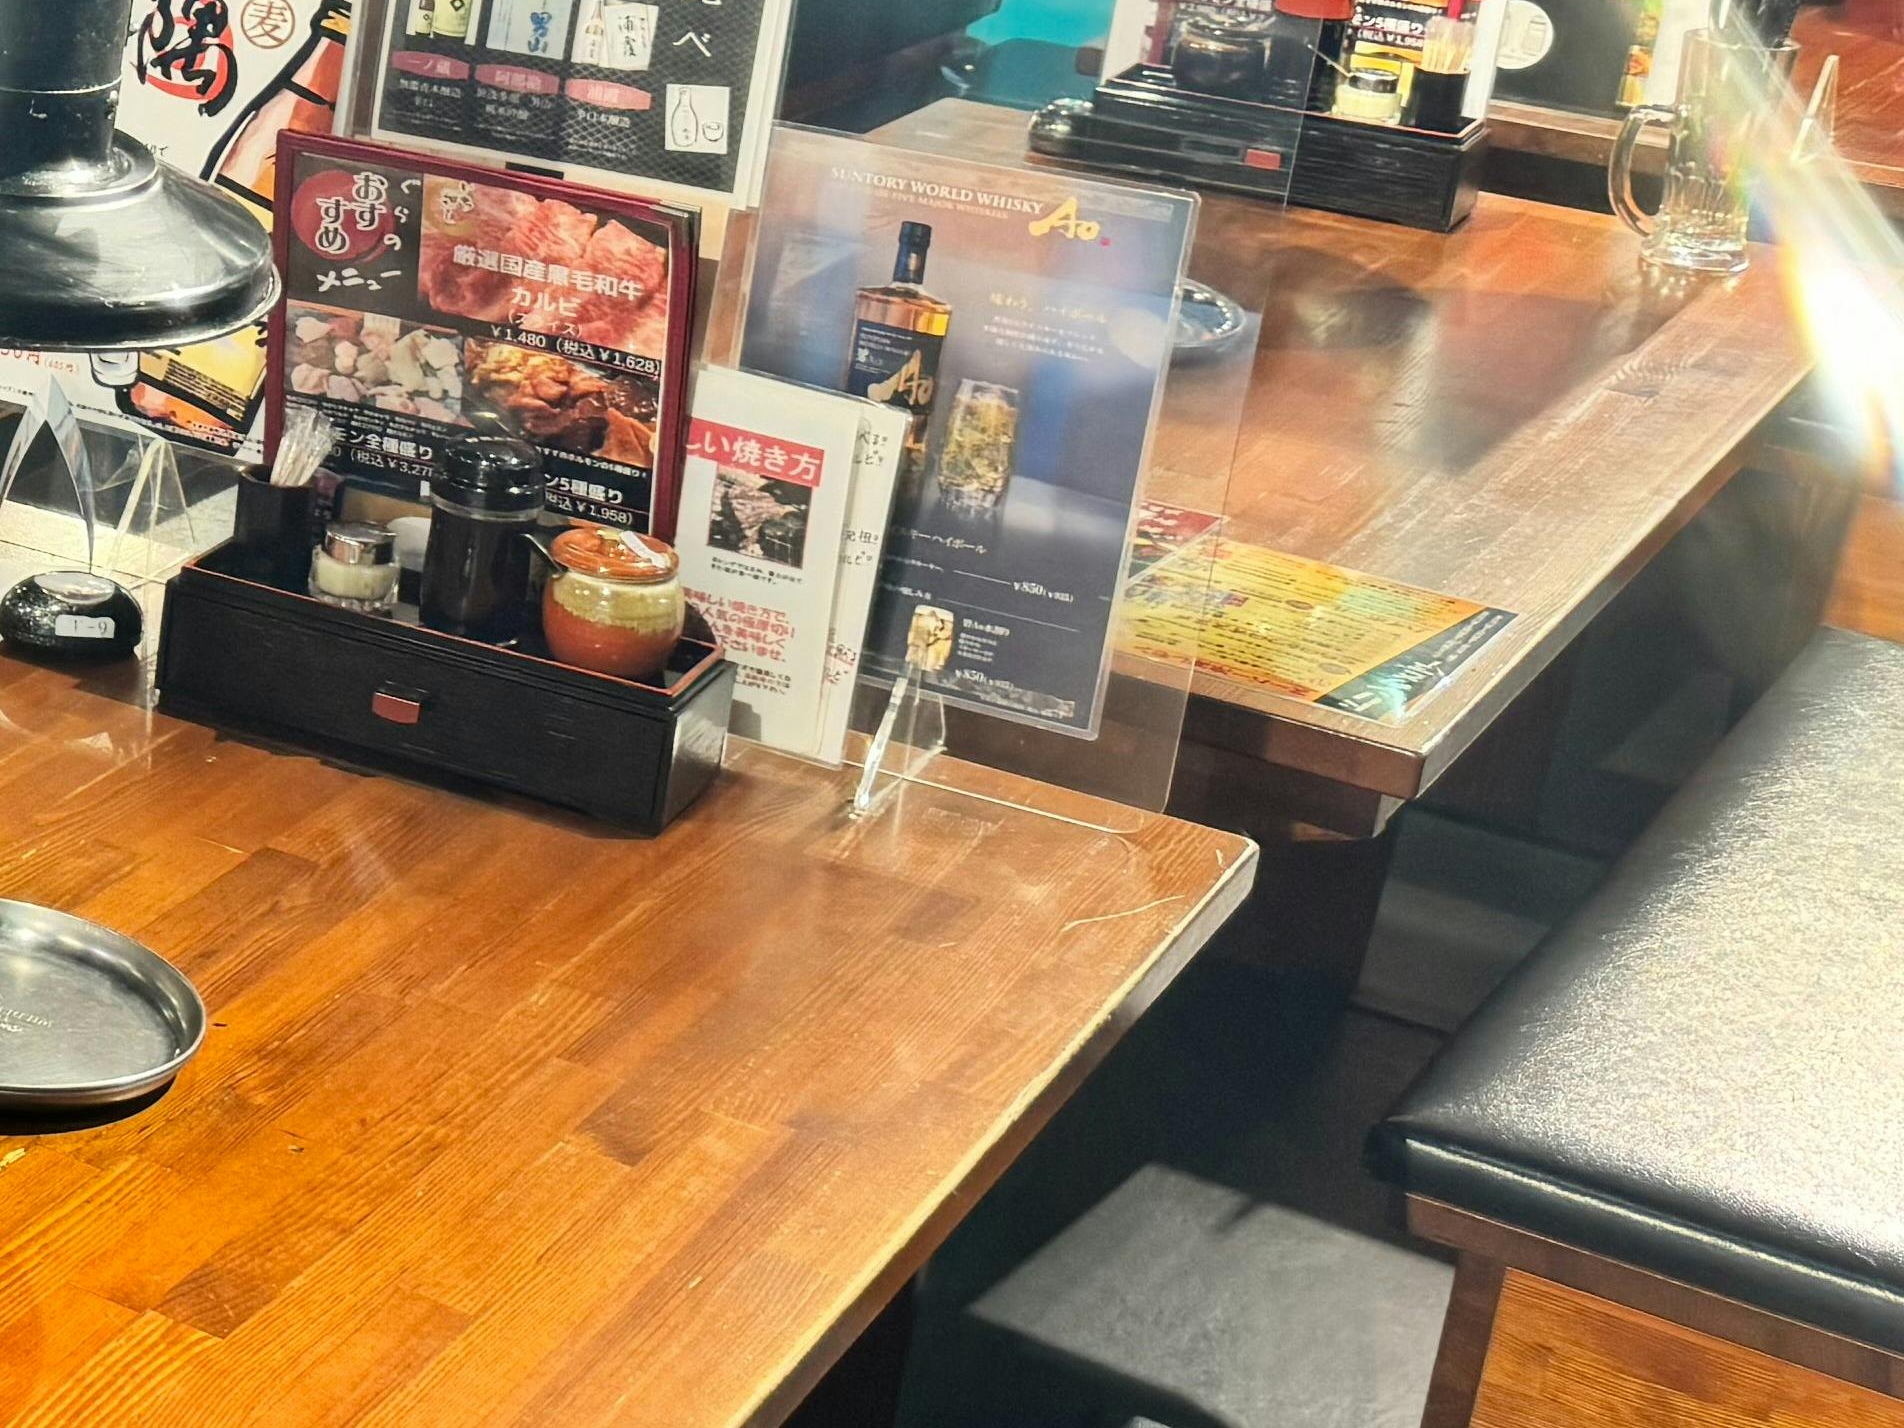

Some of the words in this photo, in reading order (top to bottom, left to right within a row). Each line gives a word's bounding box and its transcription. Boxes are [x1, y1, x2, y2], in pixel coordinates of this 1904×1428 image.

[830, 166, 907, 193] SUNTORY
[909, 178, 973, 203] WORLD
[976, 188, 1045, 215] WHISKY
[1028, 195, 1101, 241] Ao
[315, 267, 402, 293] メニュー
[452, 243, 646, 302] 厳選国産黒毛和牛
[510, 285, 583, 319] カルビ
[490, 325, 548, 349] ￥1,480
